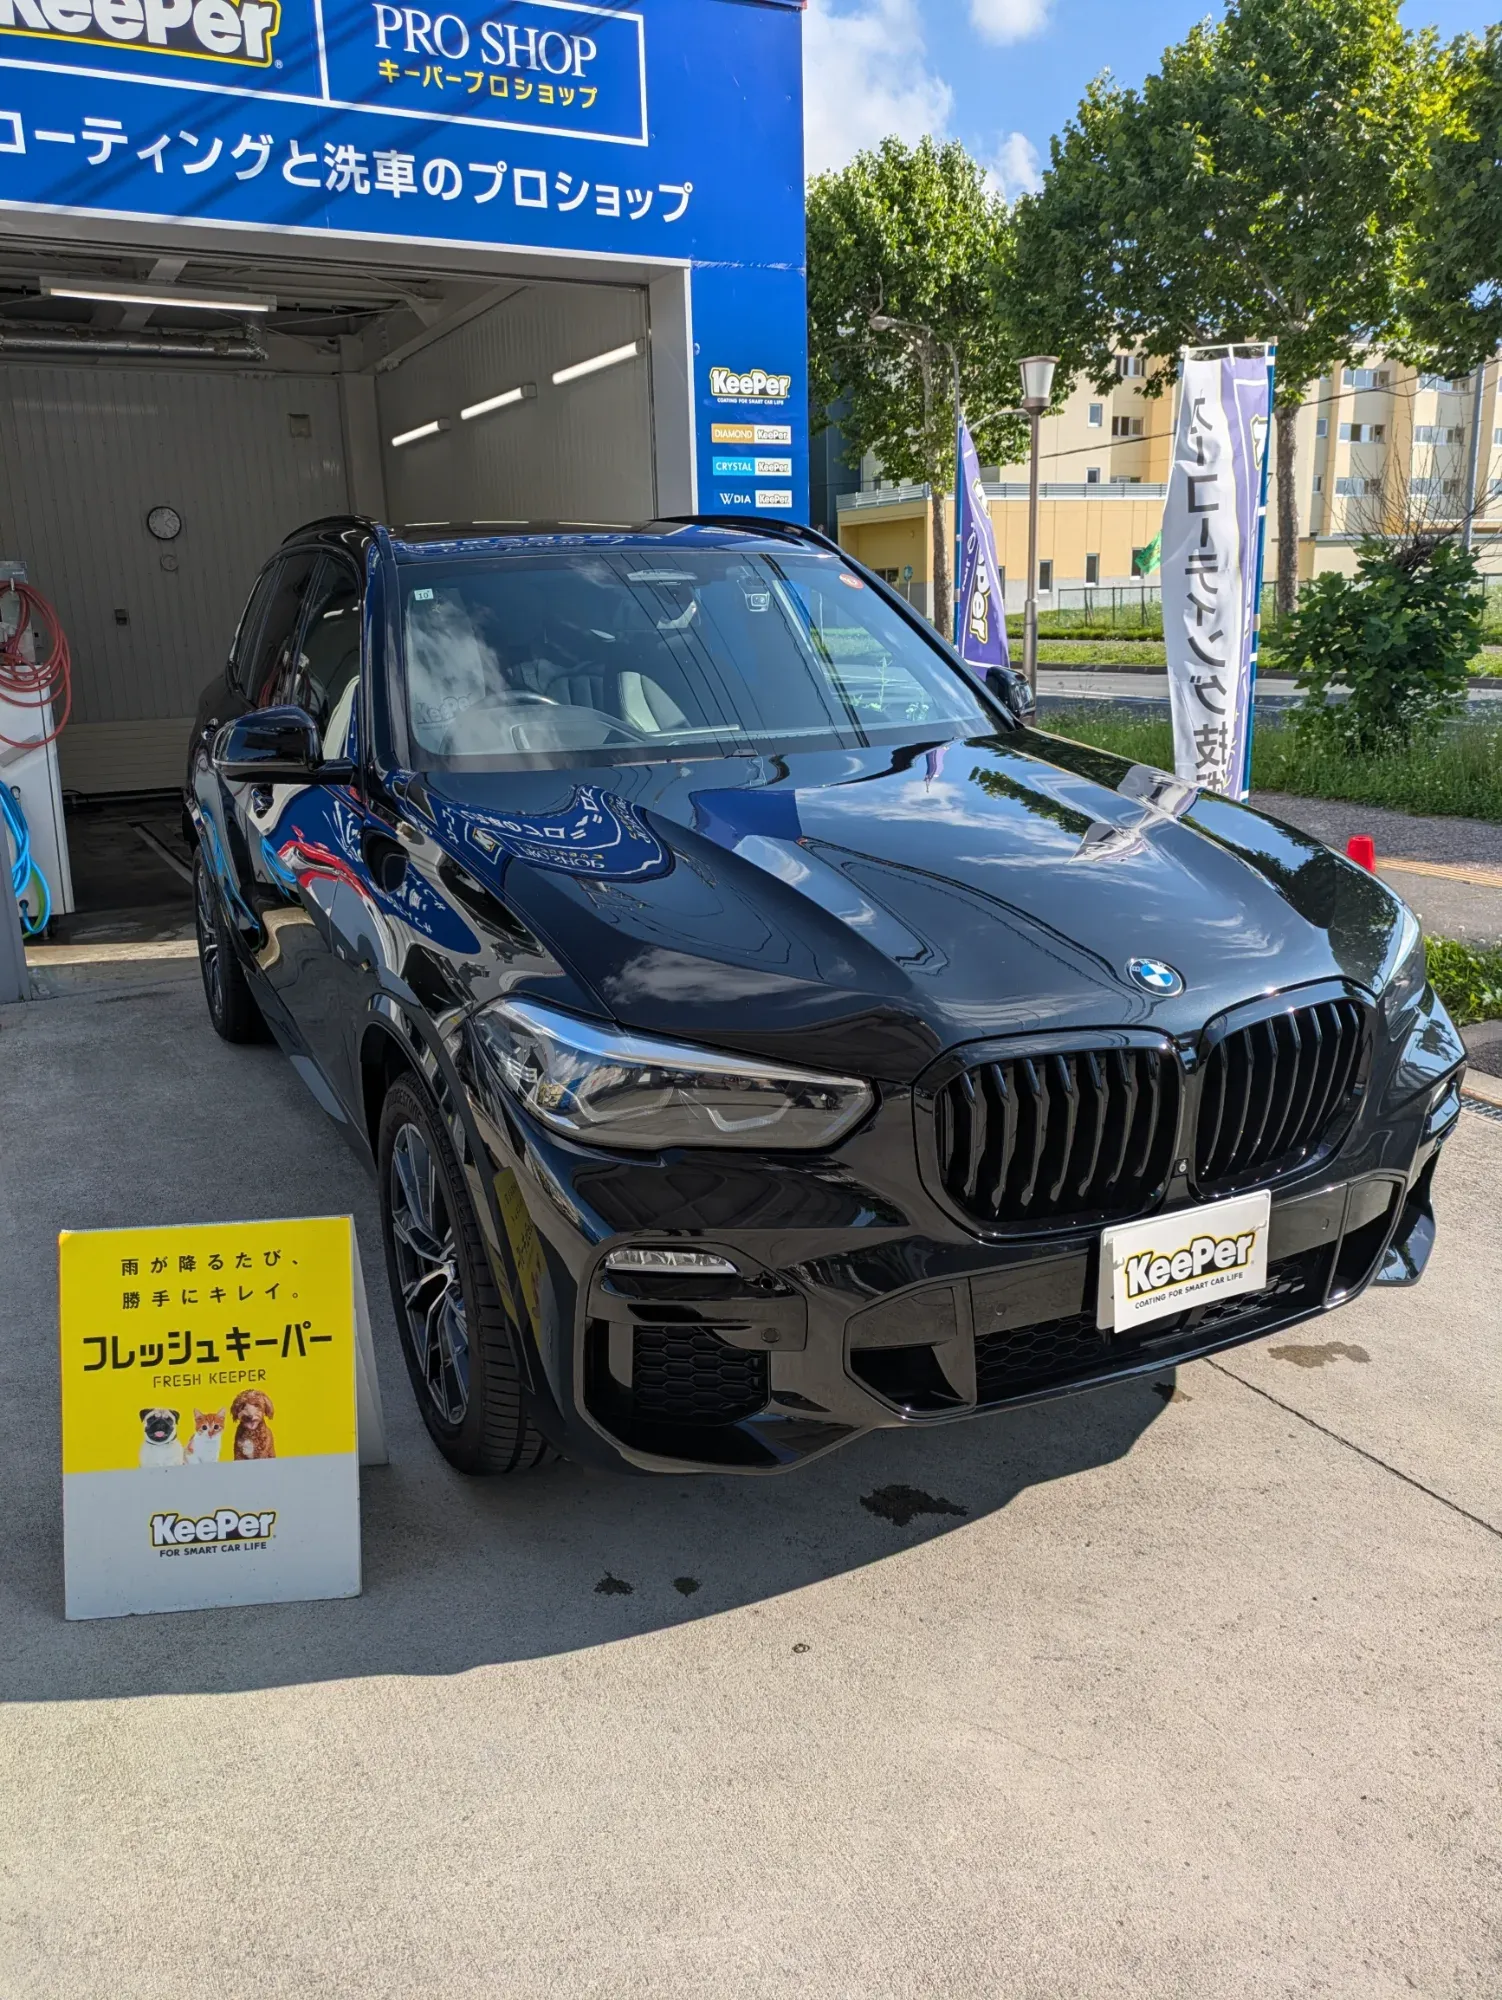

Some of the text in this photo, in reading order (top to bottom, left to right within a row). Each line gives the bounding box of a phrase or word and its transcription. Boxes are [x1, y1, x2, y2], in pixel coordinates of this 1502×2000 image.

[372, 3, 597, 77] PRO SHOP
[378, 58, 598, 109] キーパープロショップ
[711, 368, 790, 397] KeePer
[714, 429, 788, 440] DIAMOND KeePer
[716, 461, 789, 473] CRYSTAL KeePer
[758, 494, 789, 505] KeePer
[120, 1249, 299, 1277] 雨が降るたび、
[1125, 1232, 1255, 1299] KeePer
[122, 1282, 299, 1310] 勝手にキレイ。
[1134, 1271, 1243, 1309] COATING FOR SMART CAR LIFE
[82, 1320, 333, 1372] フレッシュキーパー
[153, 1368, 266, 1388] FRESH KEEPER
[150, 1509, 276, 1547] KeePer
[159, 1541, 267, 1558] FOR SMART CAR LIFE
